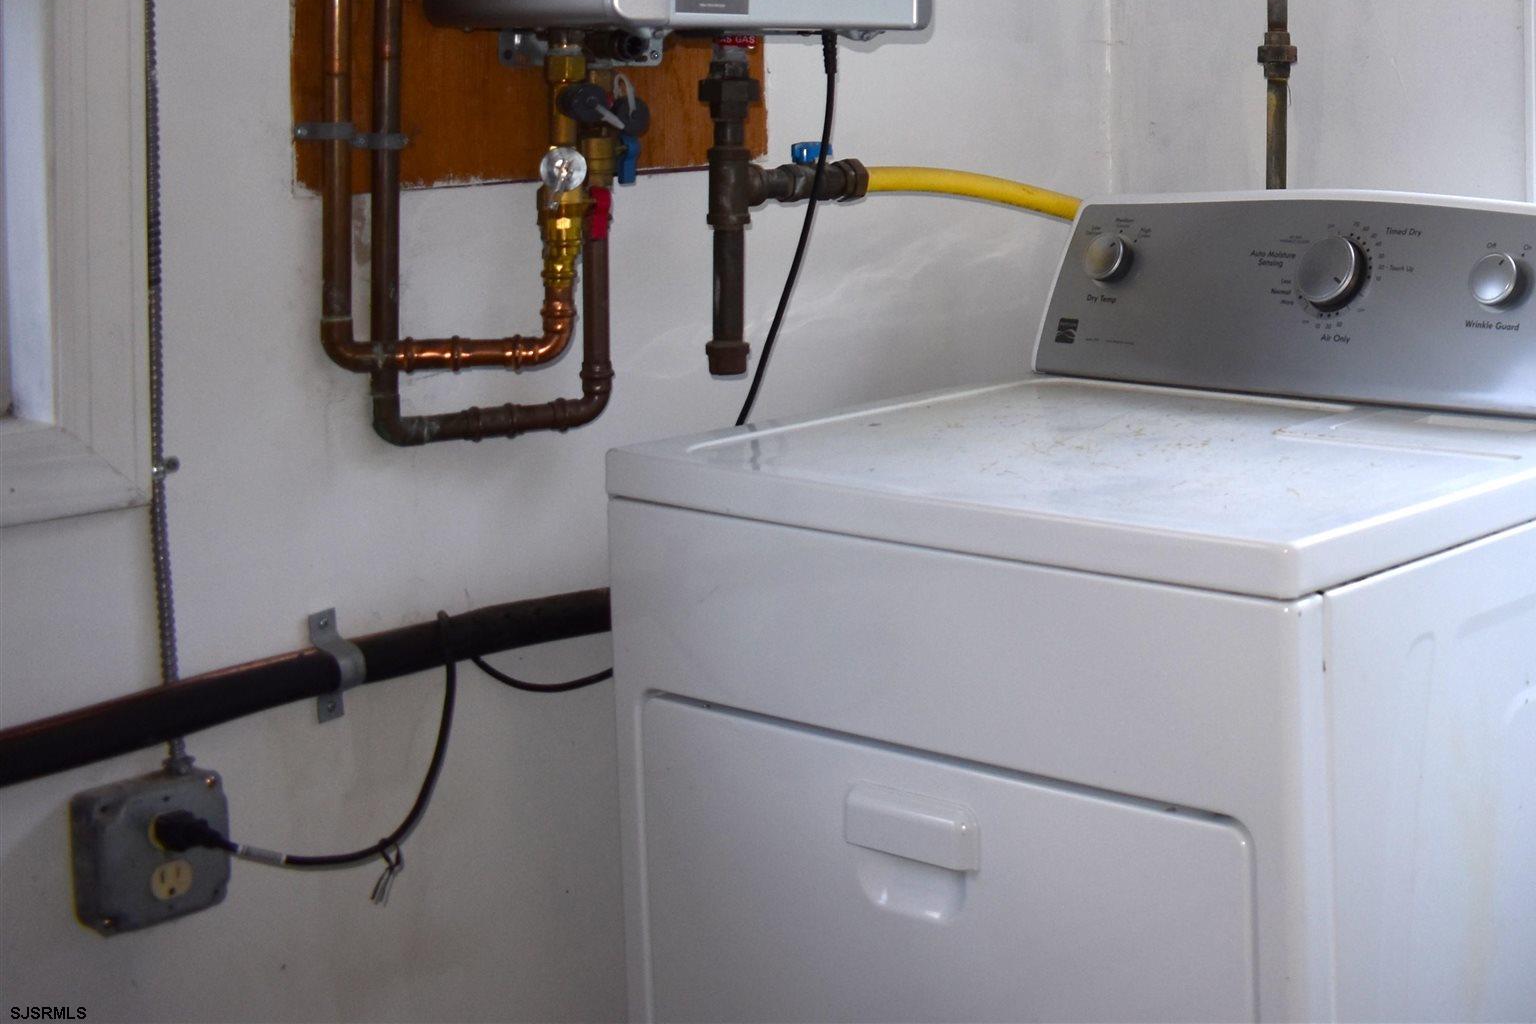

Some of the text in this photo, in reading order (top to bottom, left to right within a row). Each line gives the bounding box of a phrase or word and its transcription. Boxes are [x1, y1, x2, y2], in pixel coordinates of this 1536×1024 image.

[1386, 227, 1407, 236] Timed
[1409, 228, 1422, 237] Dry
[1250, 249, 1296, 260] Auto Moisture
[1257, 258, 1284, 268] Sensing
[1086, 294, 1117, 304] Dry Temp
[1465, 320, 1520, 331] Wrinkle Guard
[1320, 334, 1351, 344] Air Only
